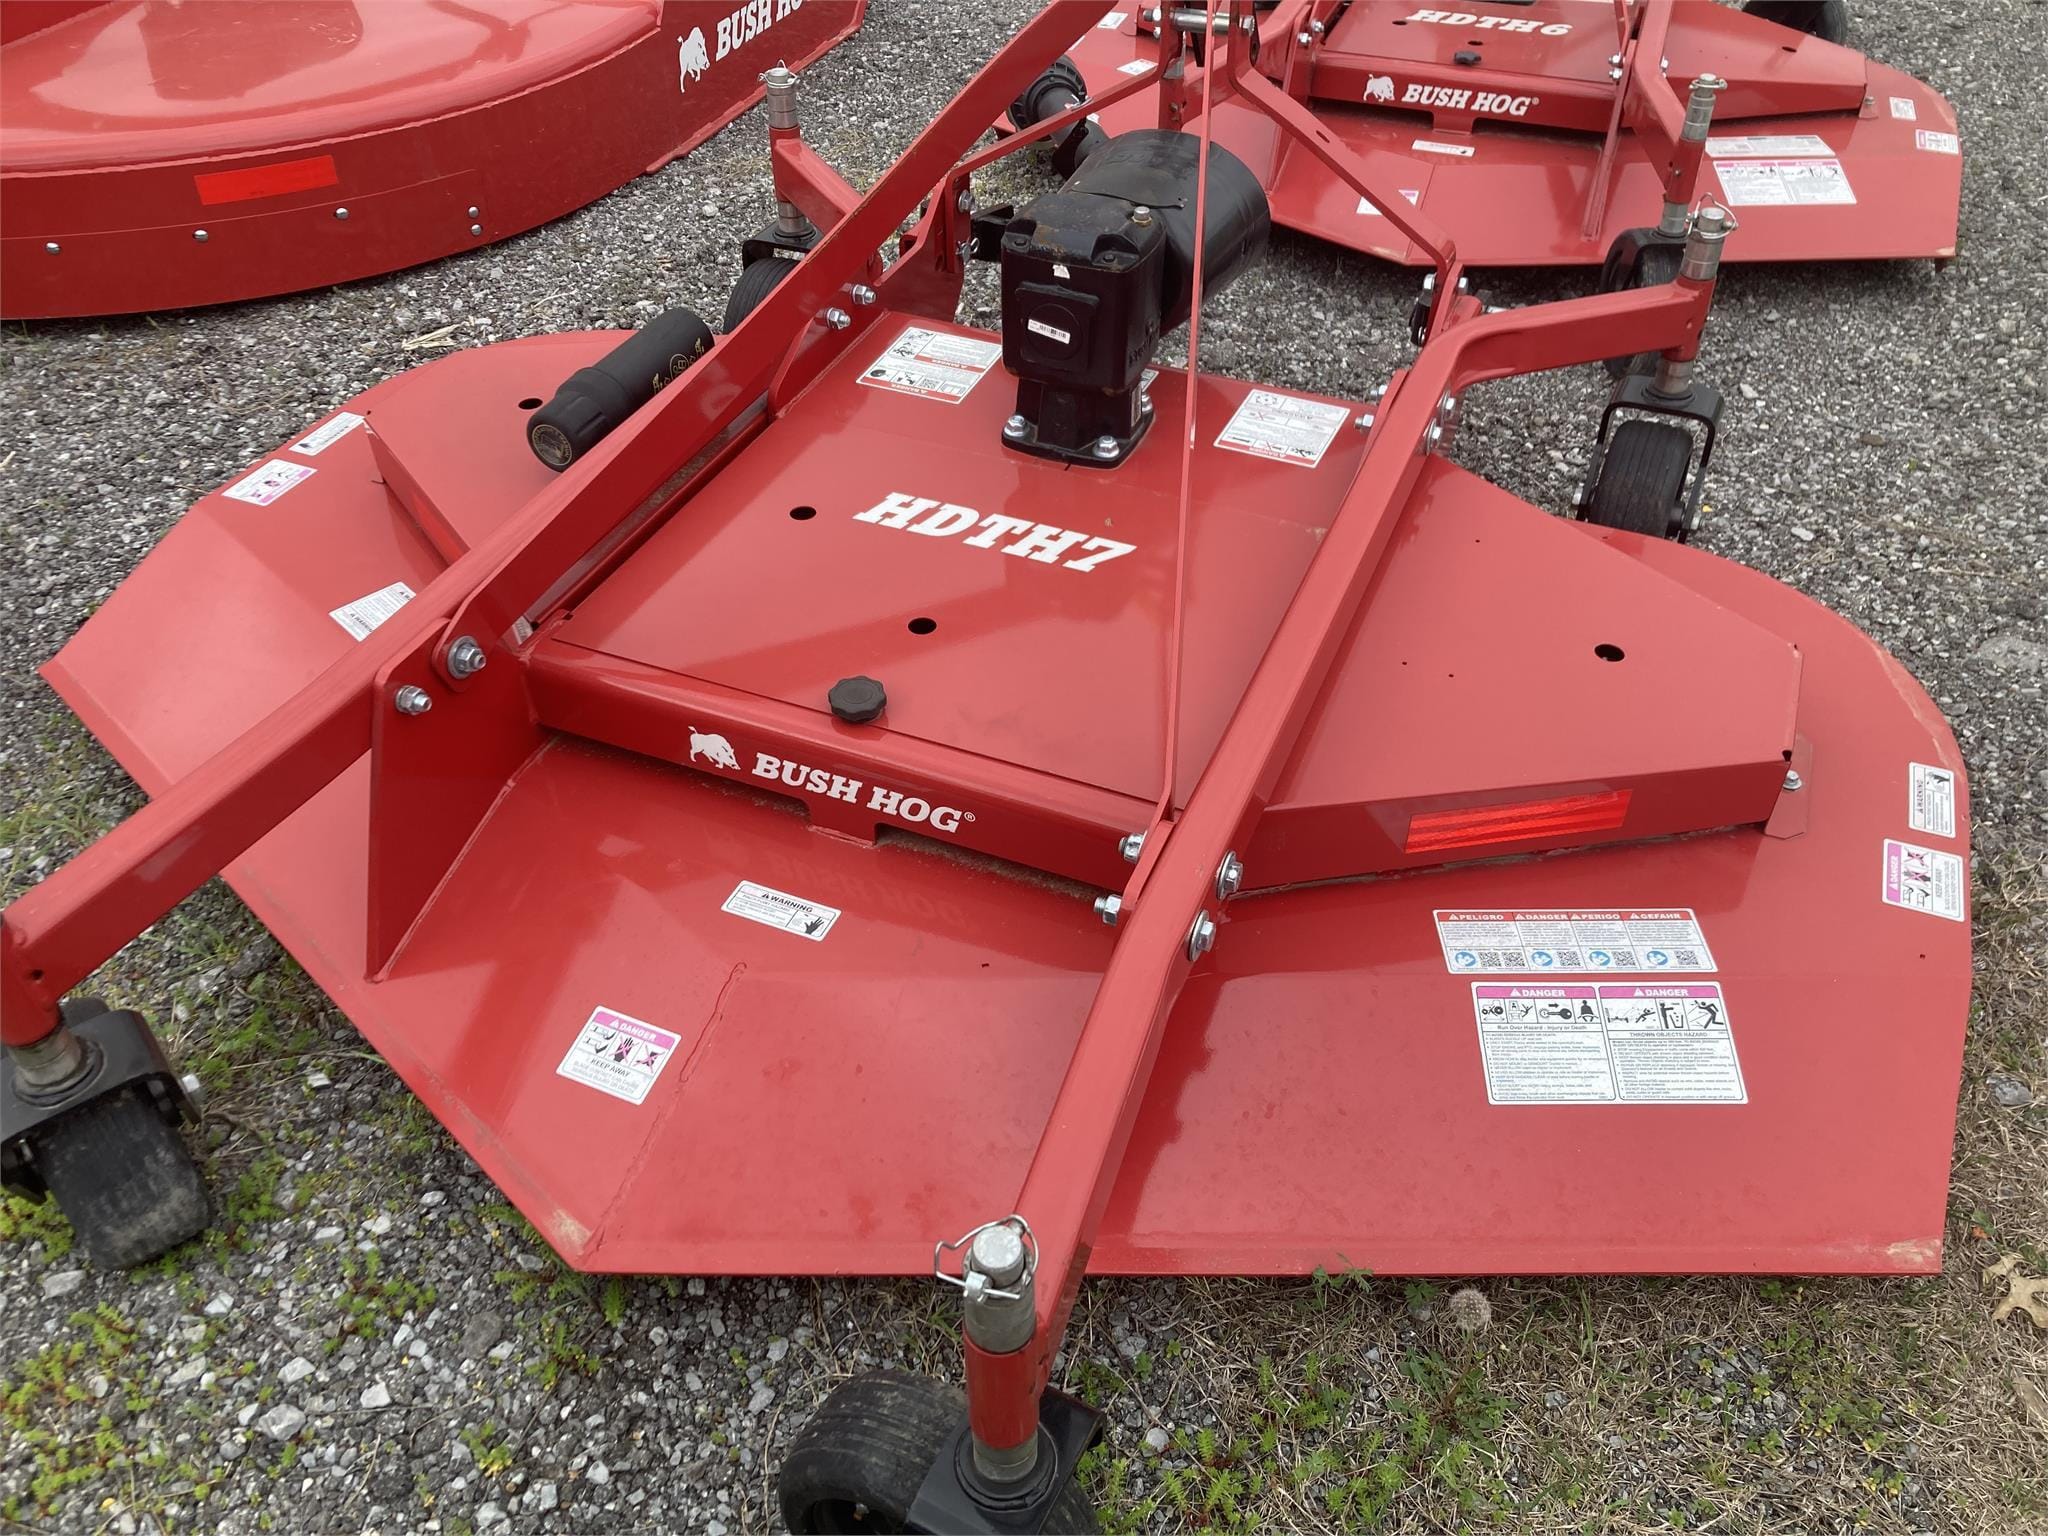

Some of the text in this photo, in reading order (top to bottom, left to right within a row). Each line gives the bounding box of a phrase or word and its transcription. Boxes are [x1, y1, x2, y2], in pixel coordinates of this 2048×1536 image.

[715, 0, 772, 62] BUSH
[1401, 83, 1473, 109] BUSH
[852, 491, 1138, 573] HDTH7
[751, 751, 863, 804] BUSH
[1890, 856, 1900, 882] DANGER
[770, 896, 814, 913] WARNING
[1458, 913, 1505, 921] PELIGRO
[1525, 913, 1569, 921] DANGER
[1581, 913, 1620, 921] PERIGO
[1521, 989, 1567, 997] DANGER
[1644, 988, 1689, 997] DANGER
[619, 1023, 657, 1041] DANGER
[590, 1058, 631, 1078] KEEP AWAY
